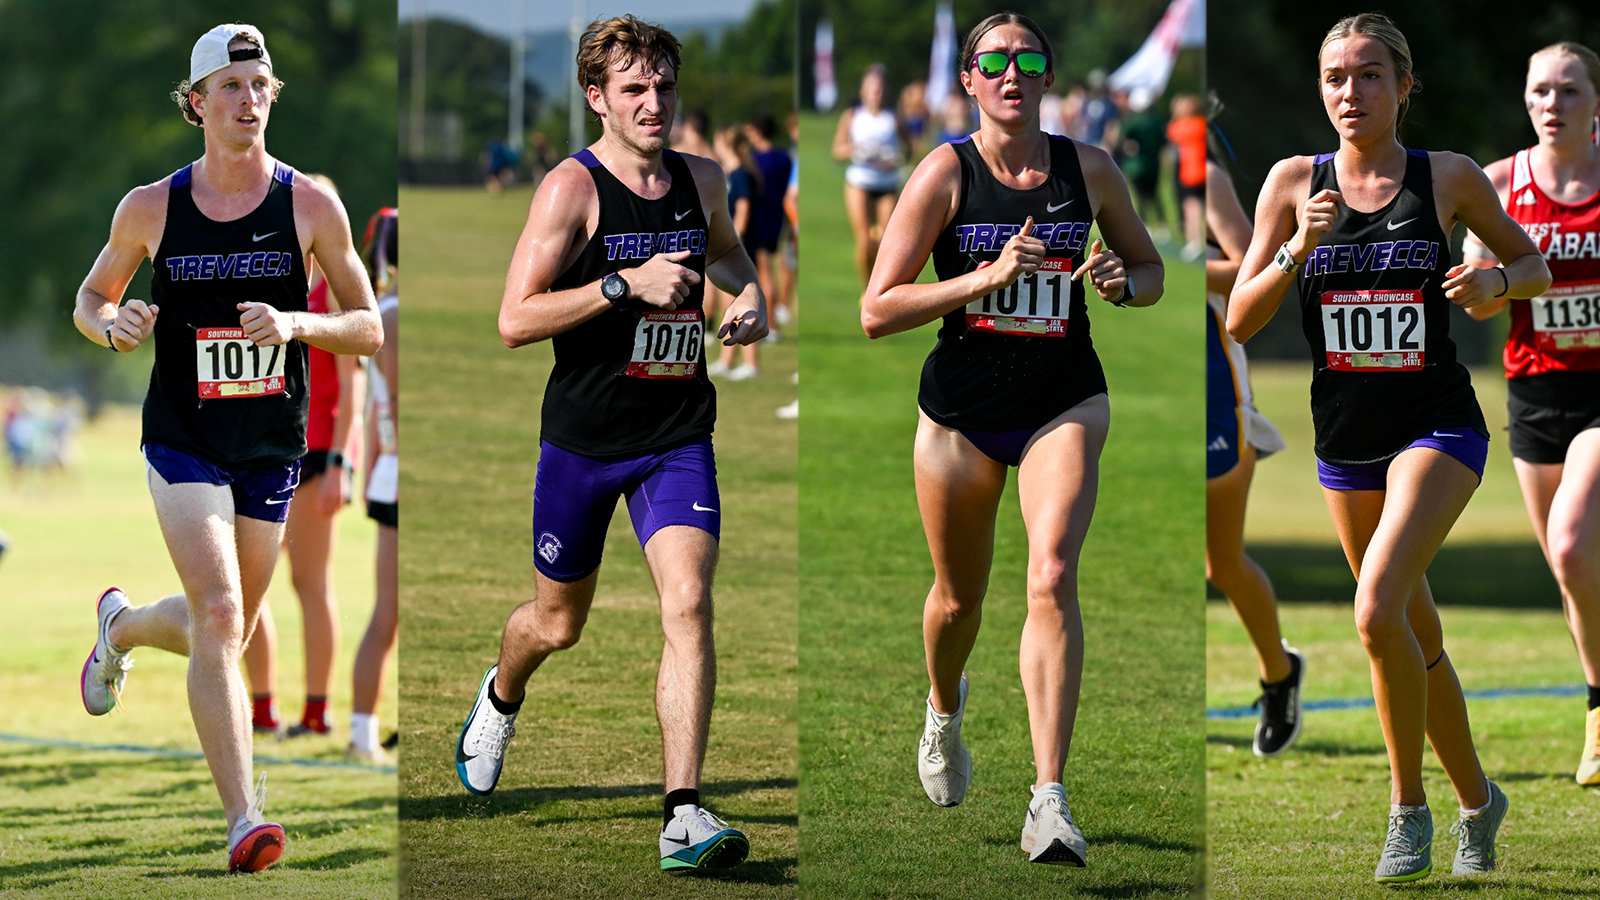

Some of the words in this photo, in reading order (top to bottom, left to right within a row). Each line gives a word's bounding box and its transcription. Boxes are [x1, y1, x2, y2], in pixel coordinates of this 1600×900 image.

[604, 229, 706, 260] TREVECCA
[1305, 240, 1439, 278] TREVECCA
[166, 252, 291, 281] TREVECCA
[982, 274, 1061, 317] 1011
[1333, 294, 1371, 303] SOUTHERN
[1373, 293, 1414, 302] SHOWCASE
[1543, 295, 1600, 328] 1138
[207, 330, 242, 339] SOUTHERN
[643, 323, 700, 362] 1016
[1330, 306, 1419, 351] 1012
[205, 341, 280, 380] 1017
[1403, 358, 1421, 366] STATE
